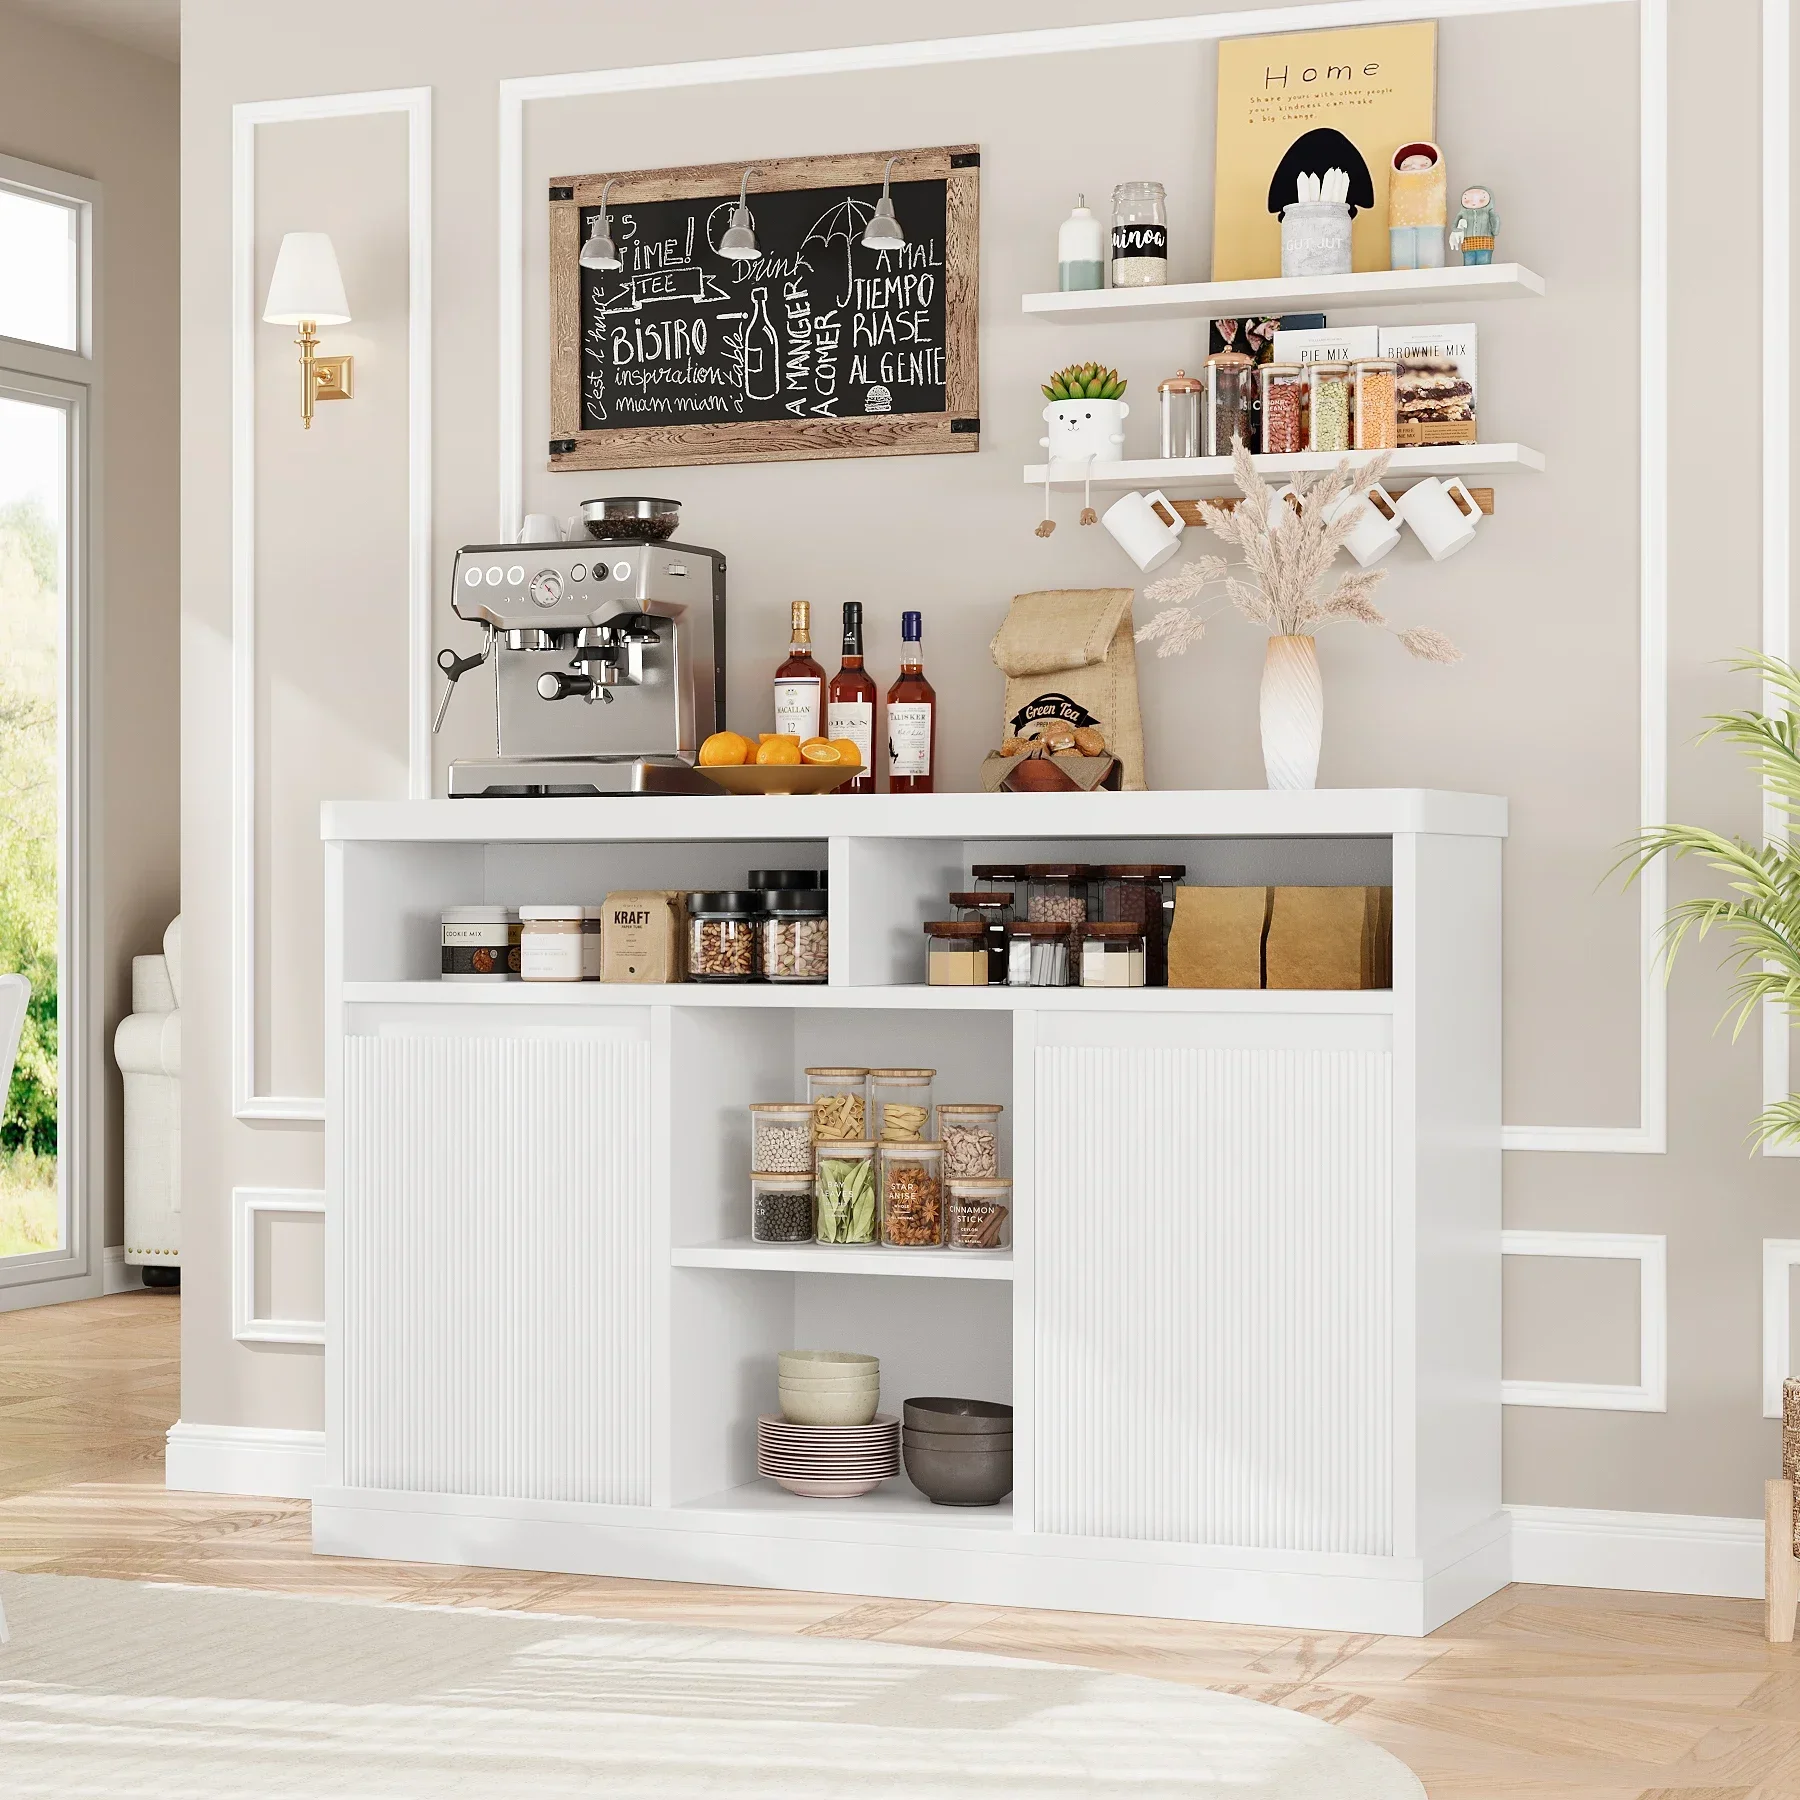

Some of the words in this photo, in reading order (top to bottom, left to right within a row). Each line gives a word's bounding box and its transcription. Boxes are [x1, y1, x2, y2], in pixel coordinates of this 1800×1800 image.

[1265, 63, 1380, 90] Home
[1250, 95, 1281, 104] Share
[1287, 94, 1310, 102] yours
[1366, 88, 1393, 96] people
[1249, 107, 1270, 115] your
[1278, 102, 1321, 111] kindness
[1262, 115, 1276, 123] big
[1111, 228, 1166, 249] uinoa
[899, 239, 943, 270] MAL
[732, 251, 814, 284] Drink
[637, 273, 677, 294] TEE
[853, 272, 935, 311] TIEMPO
[783, 276, 813, 390] MANGER
[853, 309, 933, 348] RIASE
[814, 309, 842, 396] COMER
[1301, 349, 1320, 362] PIE
[1327, 348, 1349, 361] MIX
[1388, 345, 1440, 359] BROWNIE
[1446, 344, 1467, 356] MIX
[615, 357, 726, 394] inspiration
[616, 394, 672, 413] miam
[785, 397, 807, 417] A
[810, 397, 839, 417] A
[777, 706, 811, 714] MACALLAN
[889, 712, 926, 721] TALISKER
[1025, 704, 1056, 720] Green
[1059, 702, 1080, 721] Tea
[787, 722, 796, 733] 12
[614, 910, 650, 925] KRAFT
[889, 1192, 917, 1200] ANISE
[891, 1183, 914, 1191] STAR
[949, 1205, 995, 1214] CINNAMON
